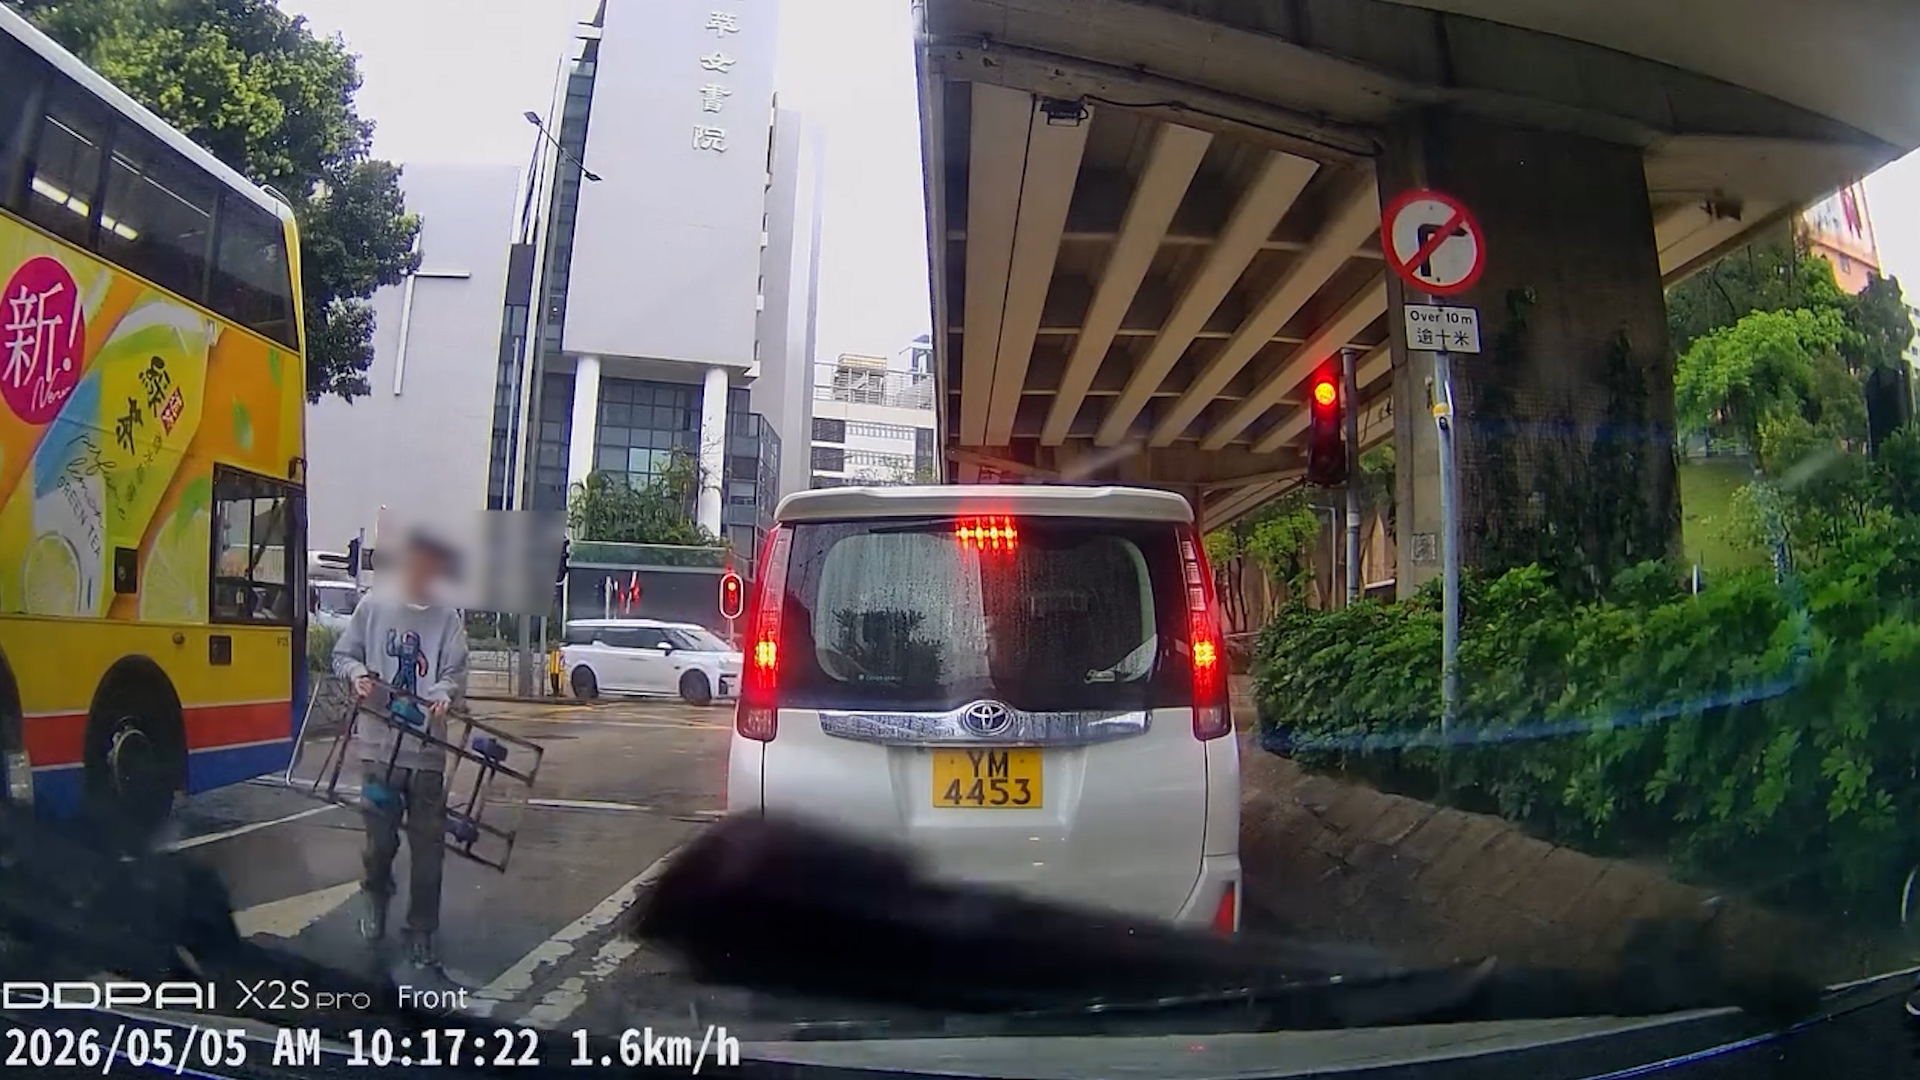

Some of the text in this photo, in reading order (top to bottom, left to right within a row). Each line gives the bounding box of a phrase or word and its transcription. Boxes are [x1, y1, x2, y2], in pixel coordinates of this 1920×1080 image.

[692, 0, 743, 153] 萃女書院
[1410, 310, 1472, 324] Over 10m
[1417, 327, 1469, 346] 逾十米
[56, 476, 102, 560] GREEN TEA
[966, 750, 1008, 777] YM
[943, 778, 1031, 805] 4453
